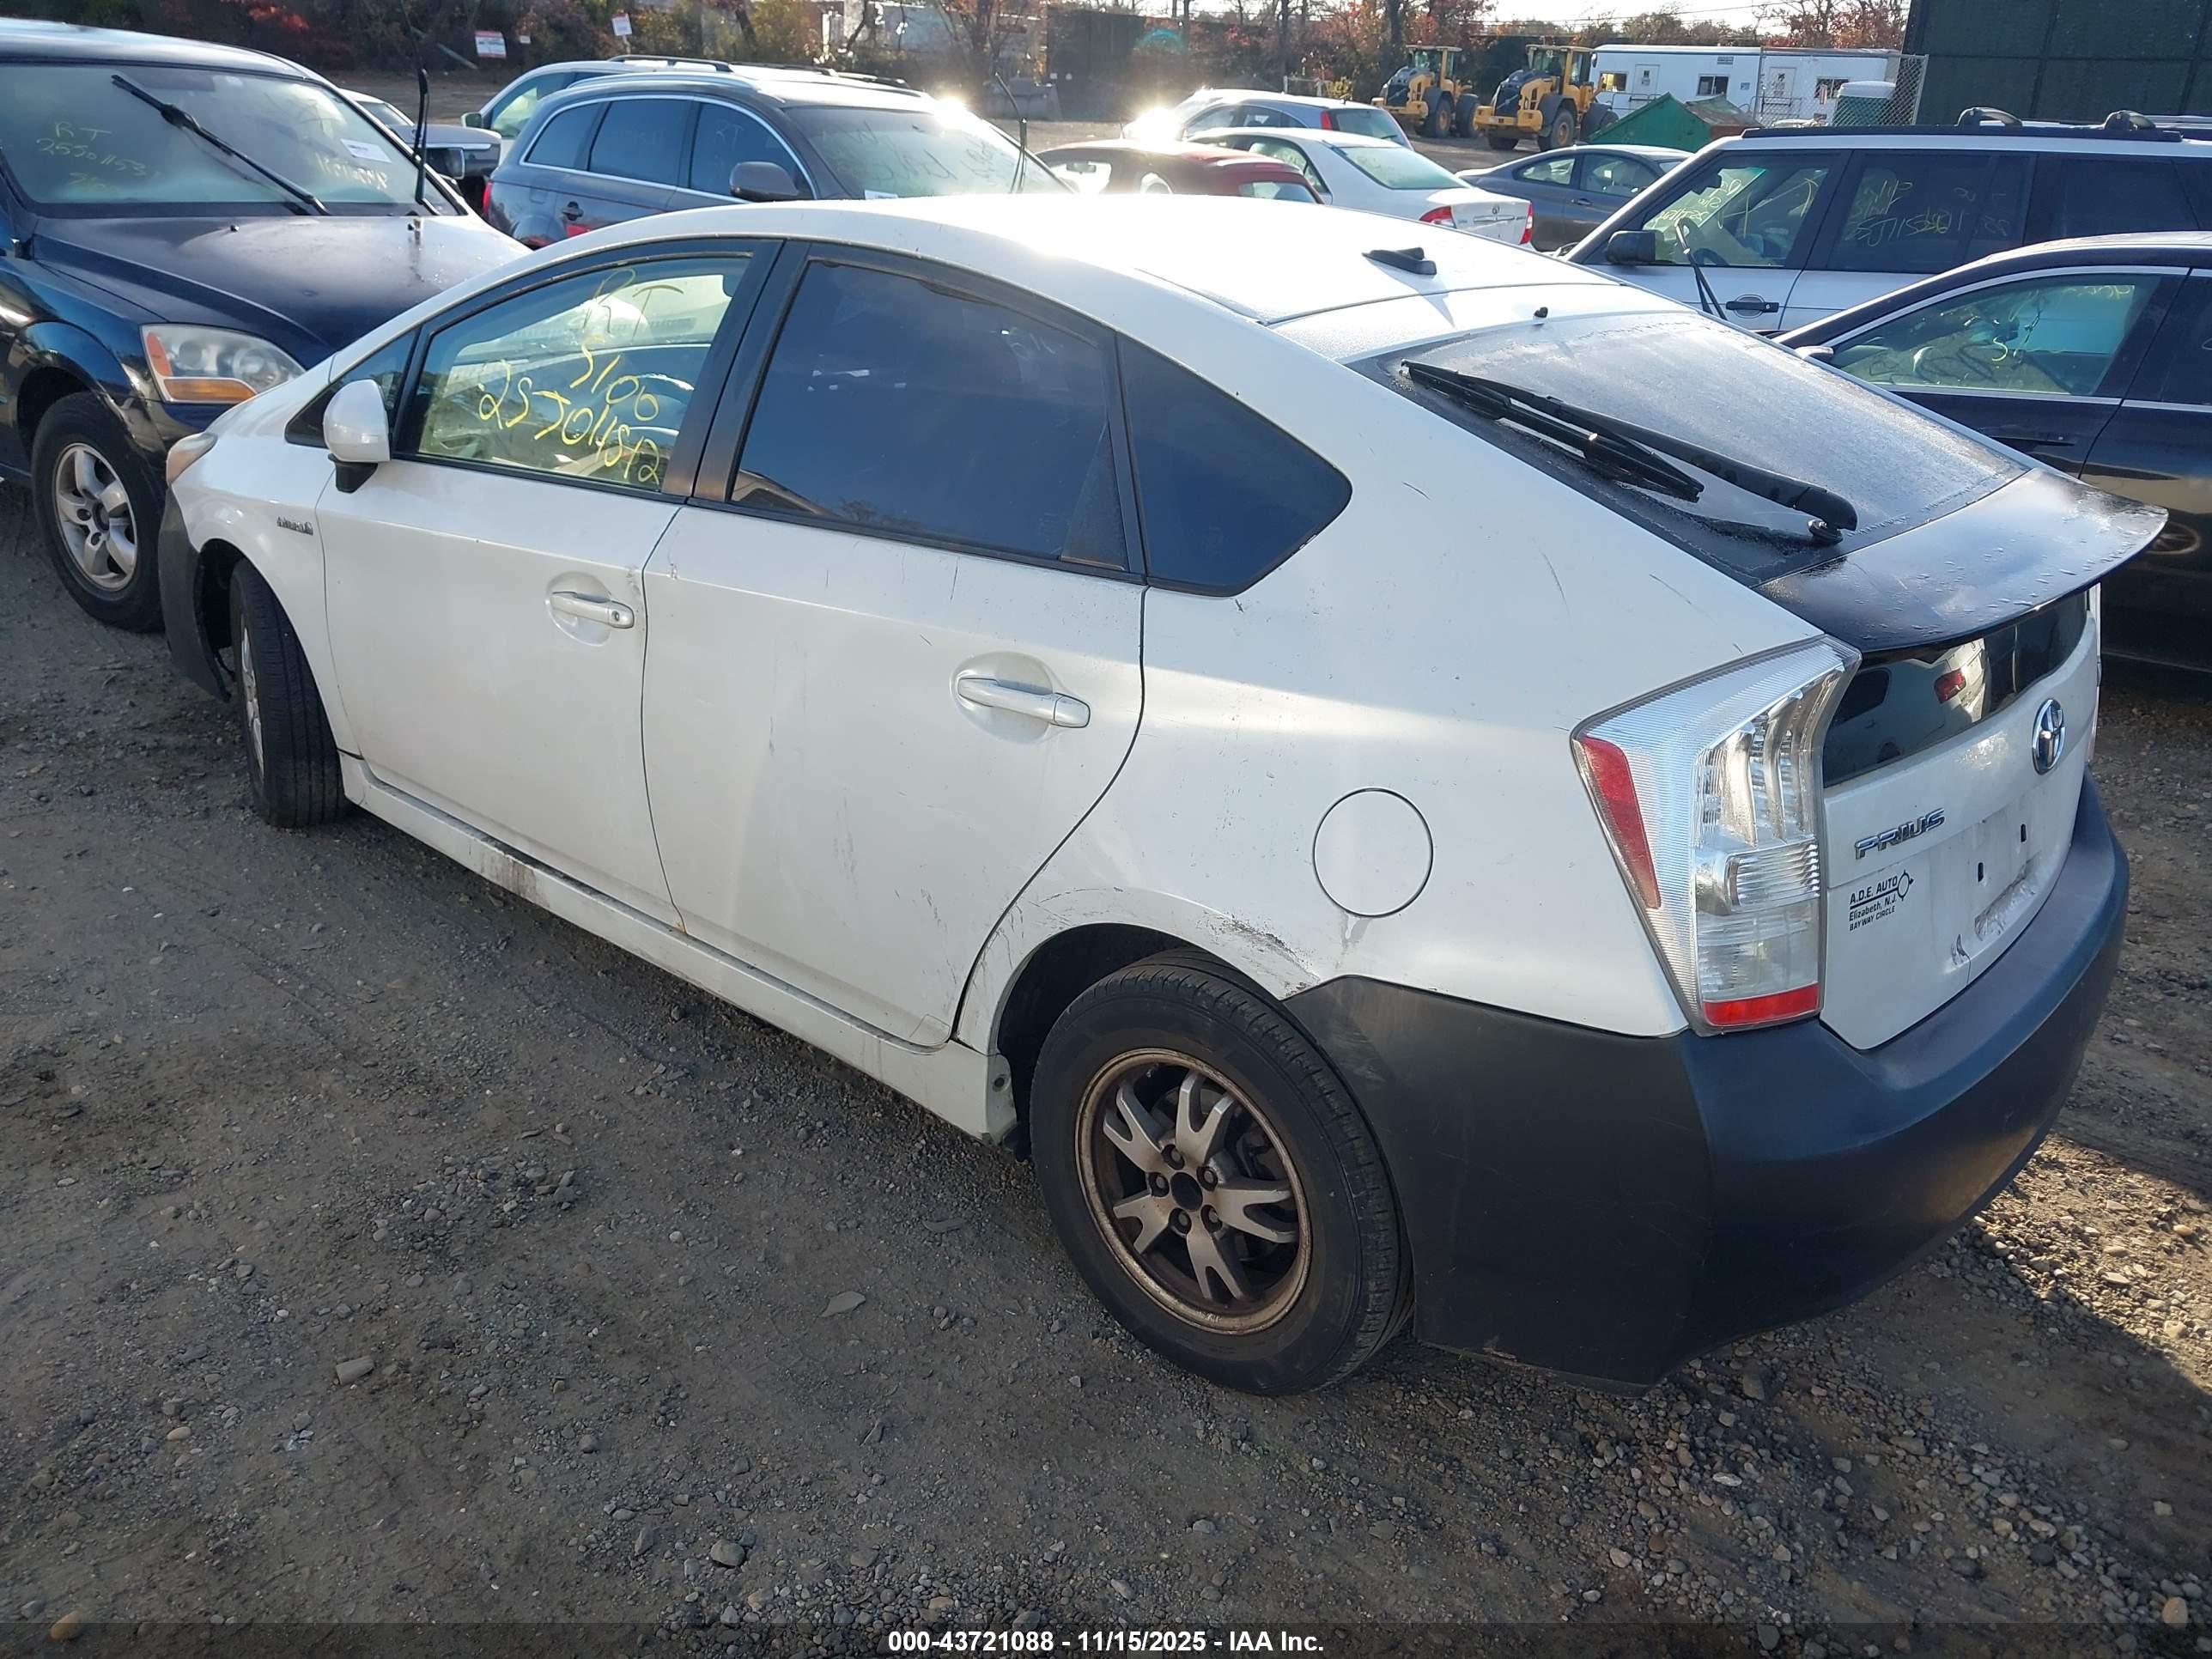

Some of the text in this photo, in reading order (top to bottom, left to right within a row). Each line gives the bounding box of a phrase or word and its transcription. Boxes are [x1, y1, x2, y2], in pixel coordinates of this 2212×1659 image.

[1854, 807, 1945, 860] PRIUS
[1876, 875, 1898, 894] AUTO
[1875, 905, 1896, 921] CIRCLE
